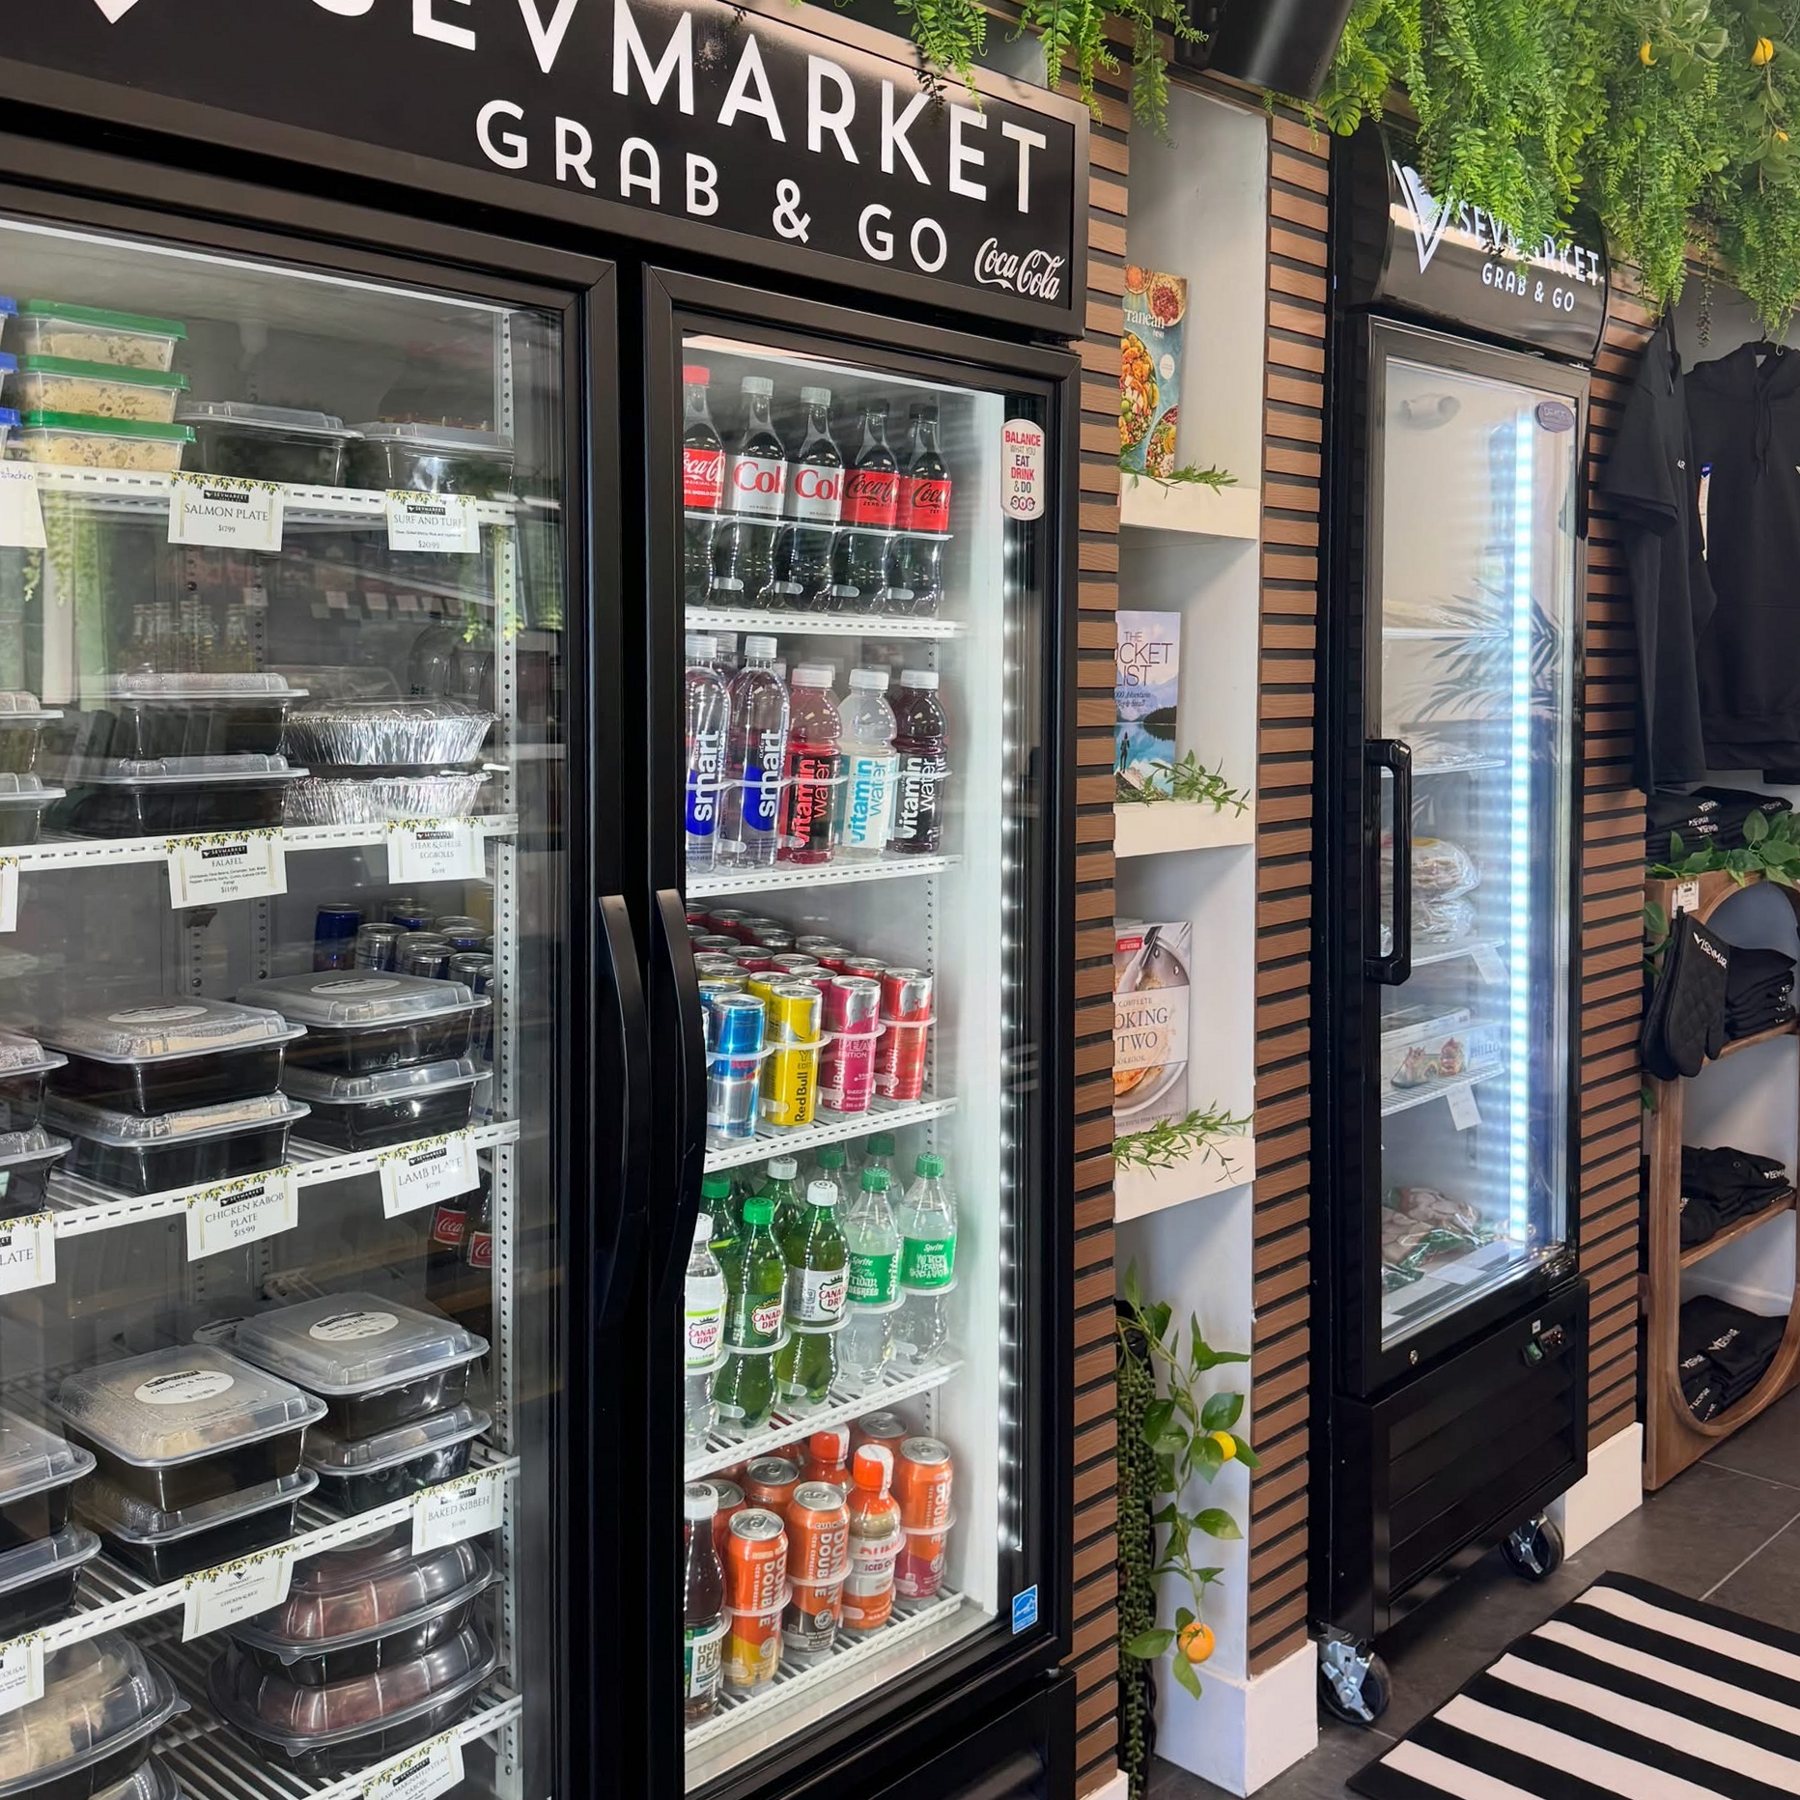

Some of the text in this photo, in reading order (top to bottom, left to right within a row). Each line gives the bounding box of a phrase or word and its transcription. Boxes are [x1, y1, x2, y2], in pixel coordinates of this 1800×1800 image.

[311, 0, 1046, 213] EVMARKET
[476, 100, 947, 273] GRAB & GO
[1482, 263, 1574, 312] GRAB & GO
[1005, 430, 1041, 447] BALANCE
[1011, 466, 1035, 480] DRINK
[1015, 454, 1030, 467] EAT
[1013, 481, 1032, 493] & DO
[184, 502, 269, 522] SALMON PLATE
[393, 514, 462, 528] SURF AND TURF
[1124, 631, 1143, 642] THE
[694, 729, 719, 821] smart
[759, 729, 782, 817] smart
[920, 757, 937, 813] water
[814, 760, 830, 818] water
[849, 759, 873, 843] vitamin
[869, 760, 887, 816] water
[899, 757, 923, 839] vitamin
[792, 759, 815, 848] vitamin
[211, 857, 243, 868] FALAFEL
[1117, 1031, 1158, 1052] TWO
[398, 1168, 429, 1186] LAMB
[205, 1192, 284, 1223] CHICKEN KABOB
[230, 1213, 258, 1228] PLATE
[761, 1320, 778, 1329] DRY
[696, 1336, 714, 1345] DRY
[428, 1505, 458, 1521] BAKED
[459, 1495, 490, 1512] KIBBEH
[815, 1532, 832, 1598] DOUBE
[864, 1563, 883, 1572] ICED
[760, 1561, 775, 1628] DOUBE
